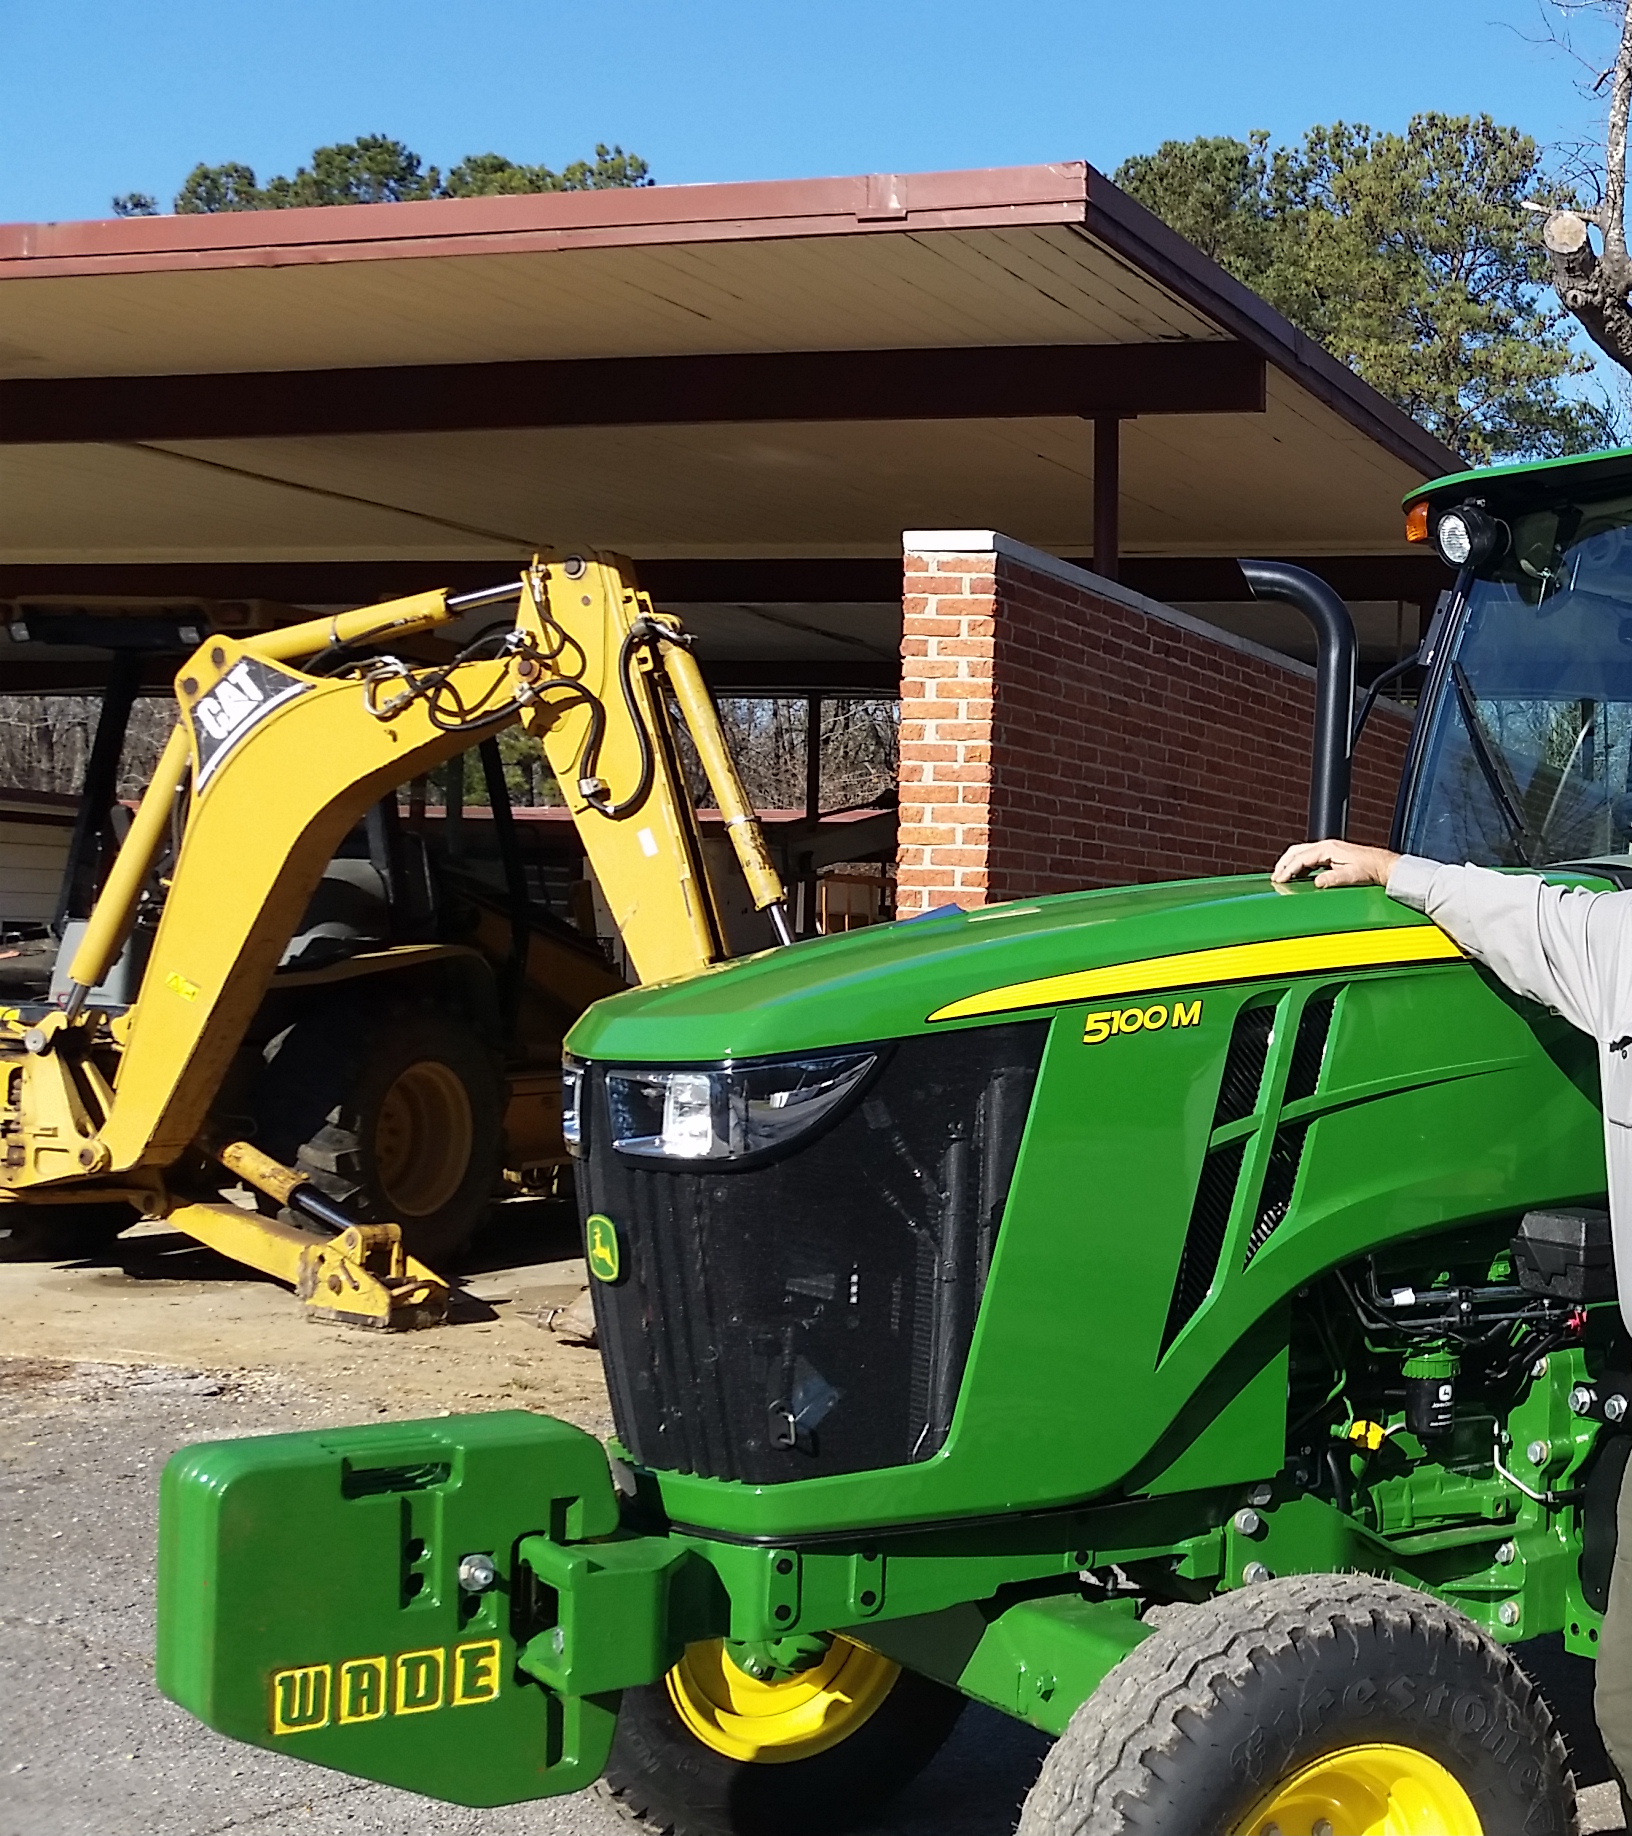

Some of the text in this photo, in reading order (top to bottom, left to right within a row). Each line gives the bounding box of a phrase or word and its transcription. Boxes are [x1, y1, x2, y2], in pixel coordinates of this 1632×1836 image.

[197, 662, 264, 740] CAT
[1083, 1007, 1168, 1044] 5100
[273, 1639, 500, 1735] WADE
